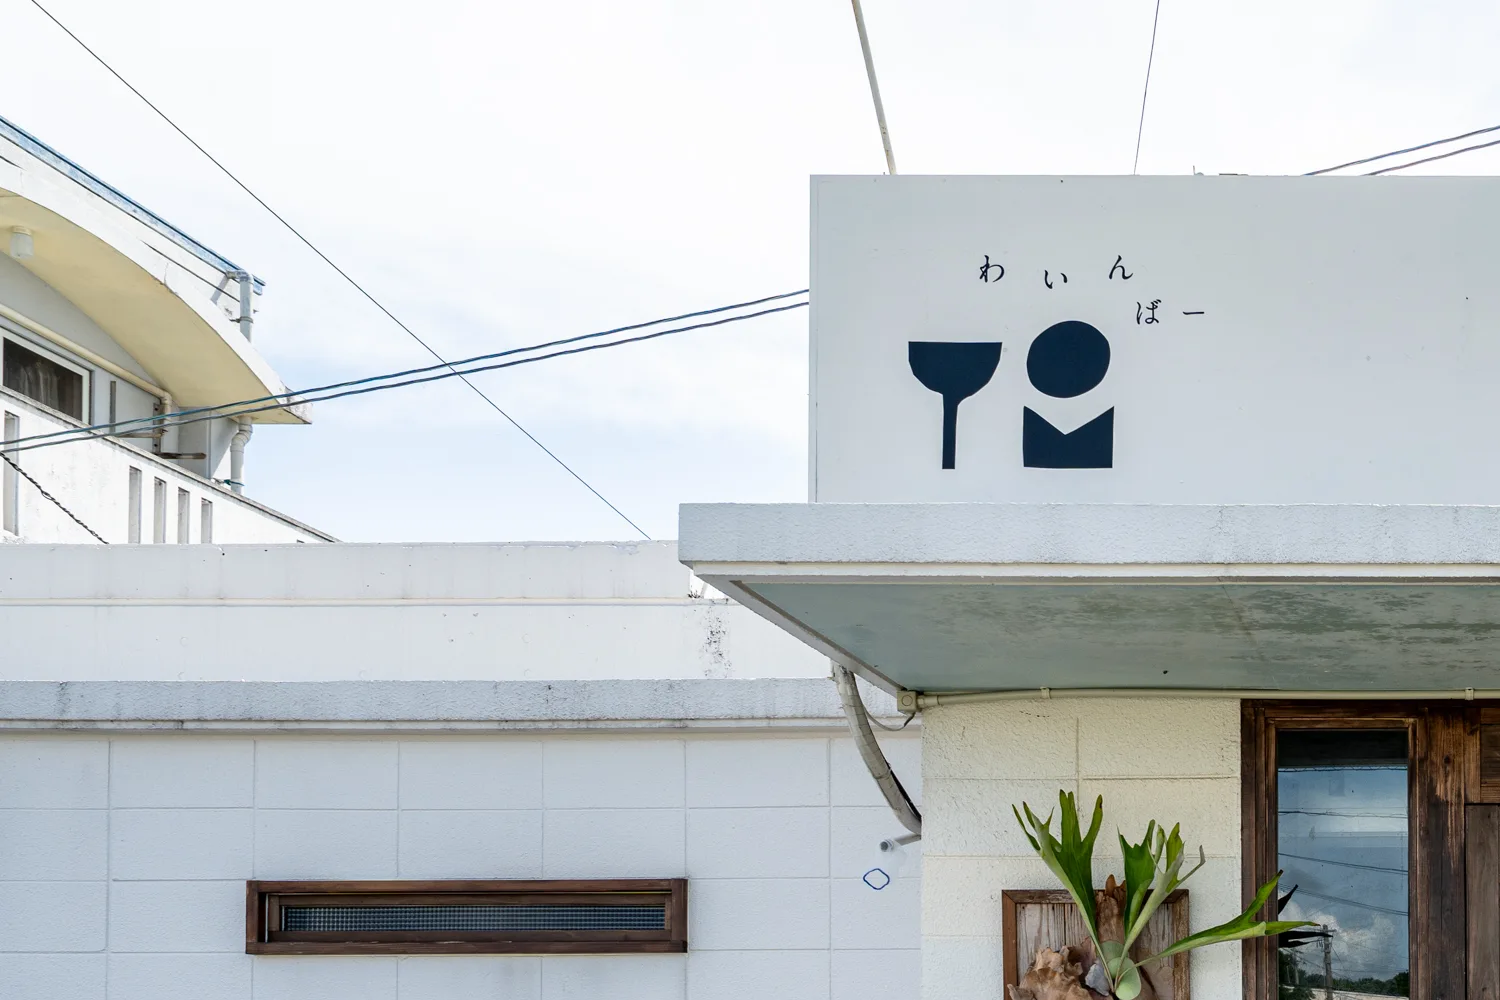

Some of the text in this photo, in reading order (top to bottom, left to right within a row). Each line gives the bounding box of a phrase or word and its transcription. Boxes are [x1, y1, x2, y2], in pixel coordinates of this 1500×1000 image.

[979, 254, 1133, 289] わいん
[1136, 299, 1205, 325] ばー
